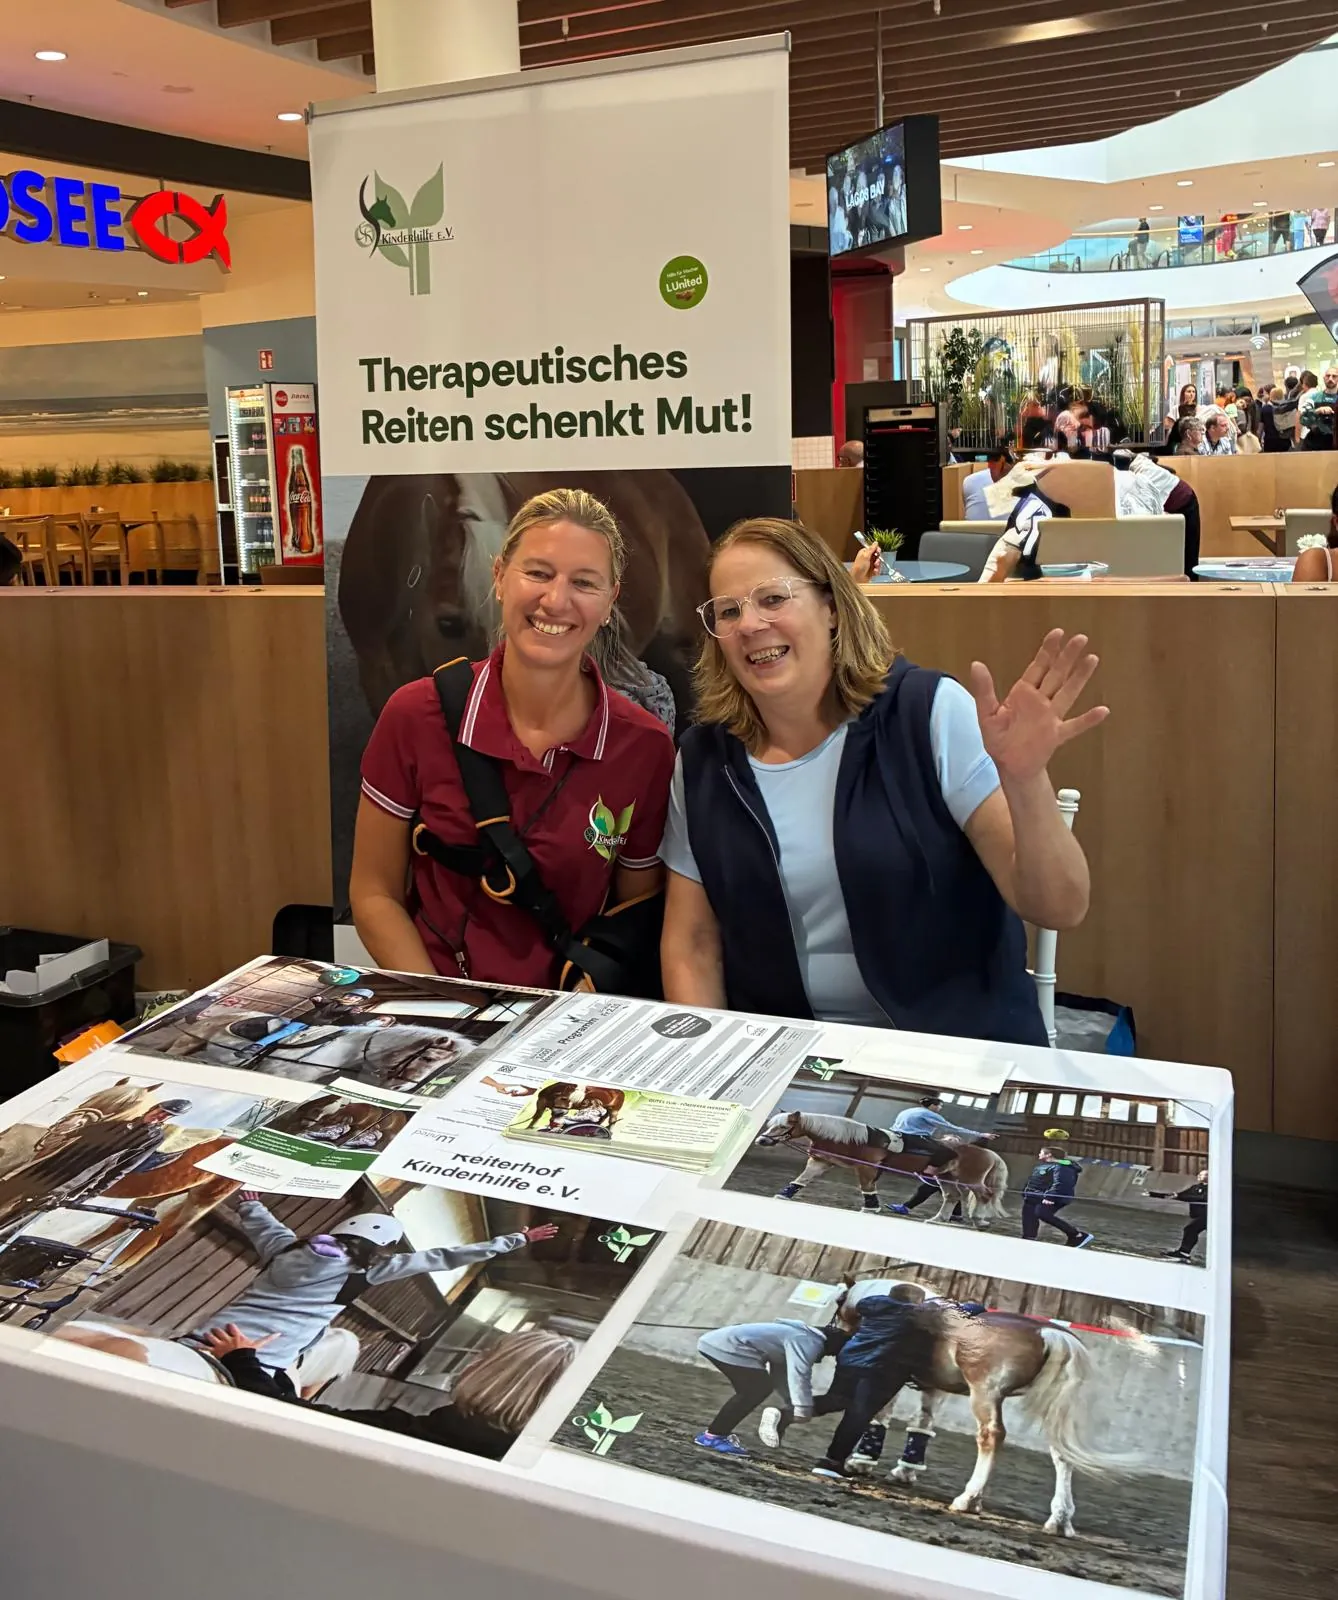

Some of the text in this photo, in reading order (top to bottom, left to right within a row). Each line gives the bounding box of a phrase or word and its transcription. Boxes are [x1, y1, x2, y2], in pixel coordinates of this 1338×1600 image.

[0, 169, 125, 252] SEE
[869, 179, 885, 199] BAY
[358, 344, 688, 398] Therapeutisches
[361, 393, 753, 445] Reiten schenkt Mut!
[558, 1017, 600, 1045] Programm
[402, 1158, 581, 1201] Kinderhilfe e.V.
